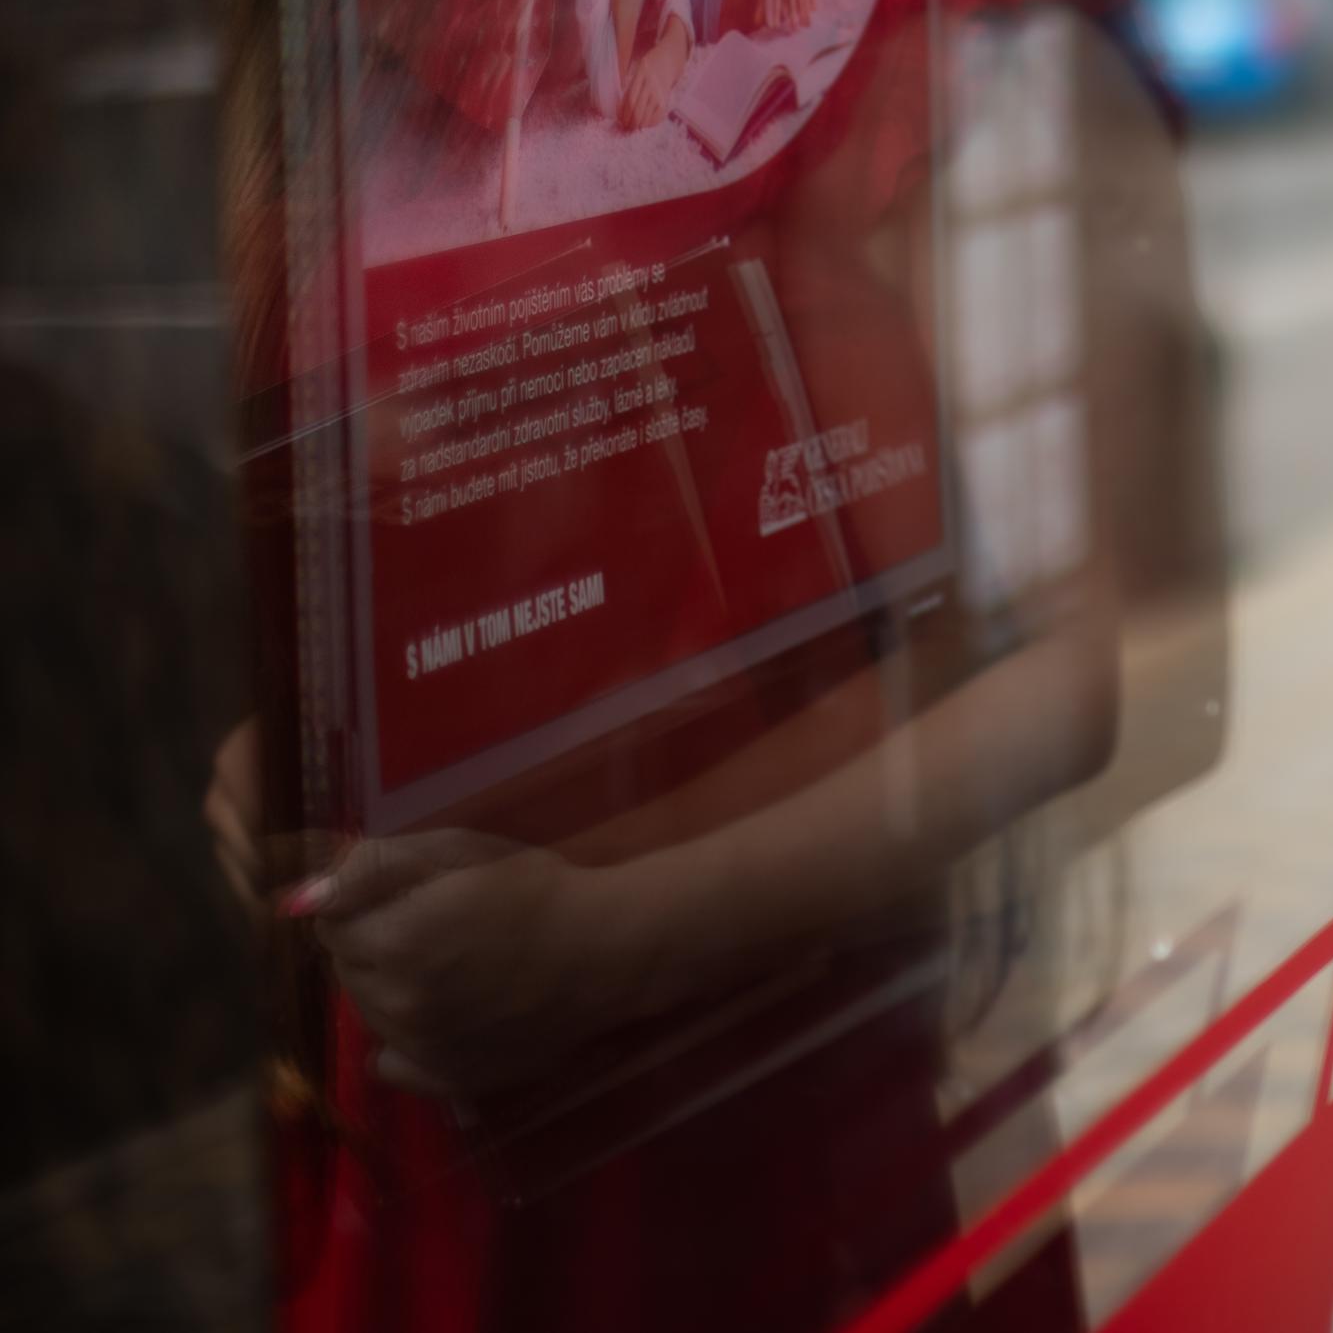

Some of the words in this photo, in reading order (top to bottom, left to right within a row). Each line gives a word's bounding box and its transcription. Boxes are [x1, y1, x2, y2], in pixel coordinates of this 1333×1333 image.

[397, 320, 407, 351] S
[453, 299, 505, 337] životním
[508, 281, 569, 327] pojištěním
[574, 276, 595, 303] vás
[598, 265, 649, 304] problémy
[651, 262, 666, 283] se
[522, 322, 590, 355] Pomůžeme
[593, 311, 618, 340] vám
[620, 309, 629, 332] v
[629, 301, 656, 328] klidu
[399, 398, 454, 444] výpadek
[458, 388, 497, 427] příjmu
[500, 377, 517, 415] při
[520, 365, 564, 404] nemoci
[567, 356, 598, 387] nebo
[600, 338, 652, 382] zaplacení
[400, 458, 417, 483] za
[419, 421, 511, 476] nadstandardní
[513, 403, 569, 446] zdravotní
[572, 395, 612, 428] služby,
[614, 382, 643, 414] lázně
[645, 384, 653, 404] a
[401, 494, 412, 526] S
[415, 489, 448, 522] námi
[450, 475, 497, 511] budete
[498, 465, 518, 494] mít
[563, 442, 578, 468] že
[581, 426, 638, 464] překonáte
[406, 642, 419, 680] S
[421, 622, 463, 675] NÁMI
[464, 620, 475, 657] V
[477, 607, 512, 650] TOM
[513, 585, 567, 638] NEJSTE
[568, 570, 605, 616] SAMI
